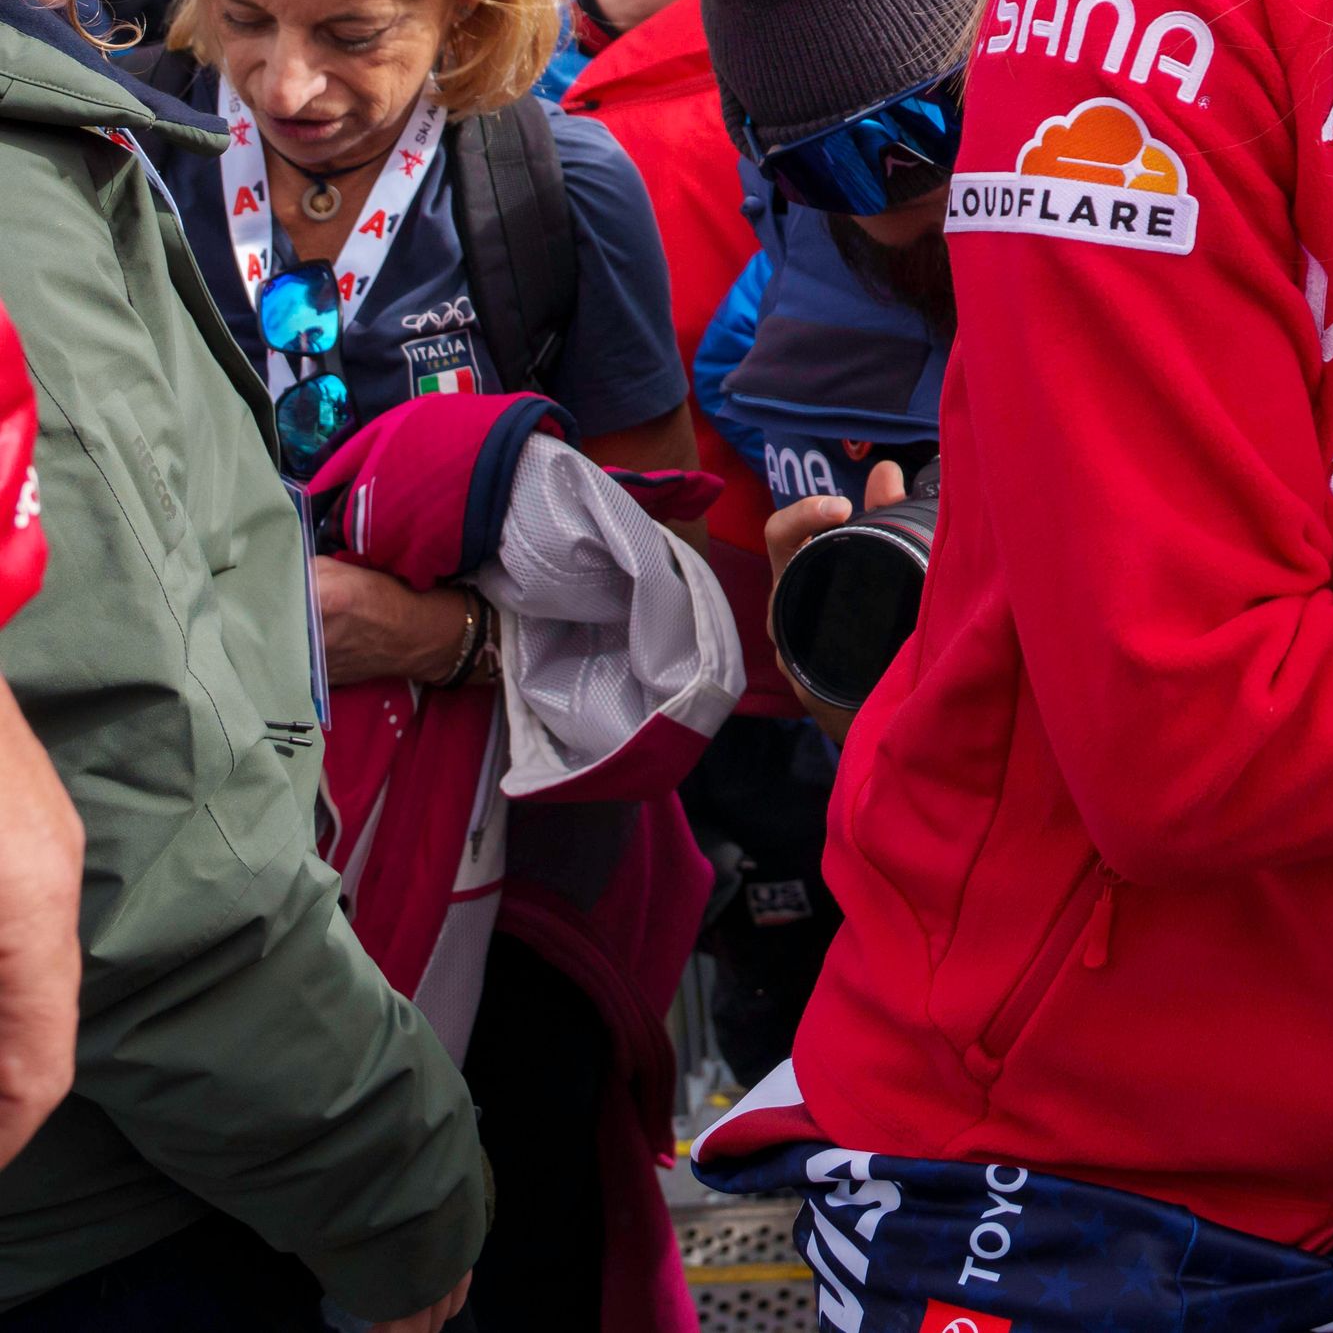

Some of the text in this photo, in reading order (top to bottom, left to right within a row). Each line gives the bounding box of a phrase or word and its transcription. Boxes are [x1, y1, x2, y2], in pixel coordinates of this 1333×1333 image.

[233, 180, 266, 216] A1
[358, 209, 401, 240] A1
[247, 248, 268, 282] A1
[337, 271, 370, 302] A1
[412, 339, 467, 363] ITALIA
[427, 355, 460, 371] TEAM
